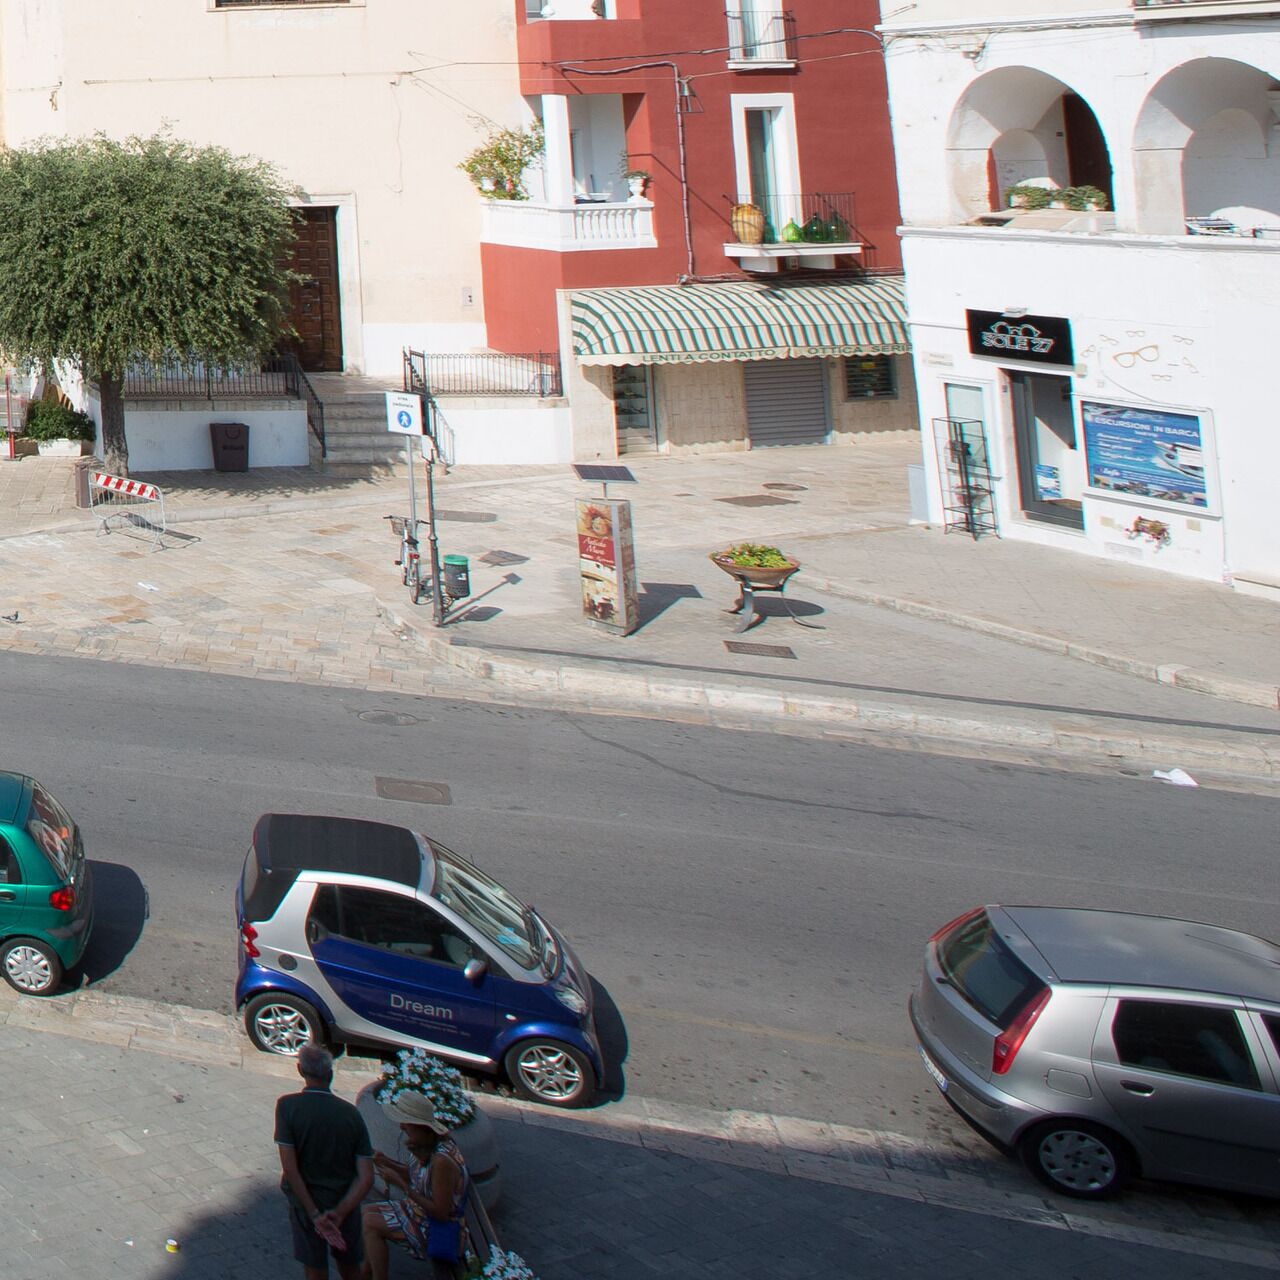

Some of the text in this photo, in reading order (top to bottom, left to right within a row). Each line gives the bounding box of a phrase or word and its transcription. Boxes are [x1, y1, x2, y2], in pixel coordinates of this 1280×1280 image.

[807, 344, 863, 355] OTTICA
[981, 331, 1056, 353] SOLE 27
[642, 354, 680, 363] LENTI
[699, 349, 776, 361] CONTATTO
[1095, 416, 1151, 431] ESCURSIONI
[1153, 425, 1164, 433] IN
[1165, 426, 1200, 438] BARCA
[390, 993, 454, 1020] Dream
